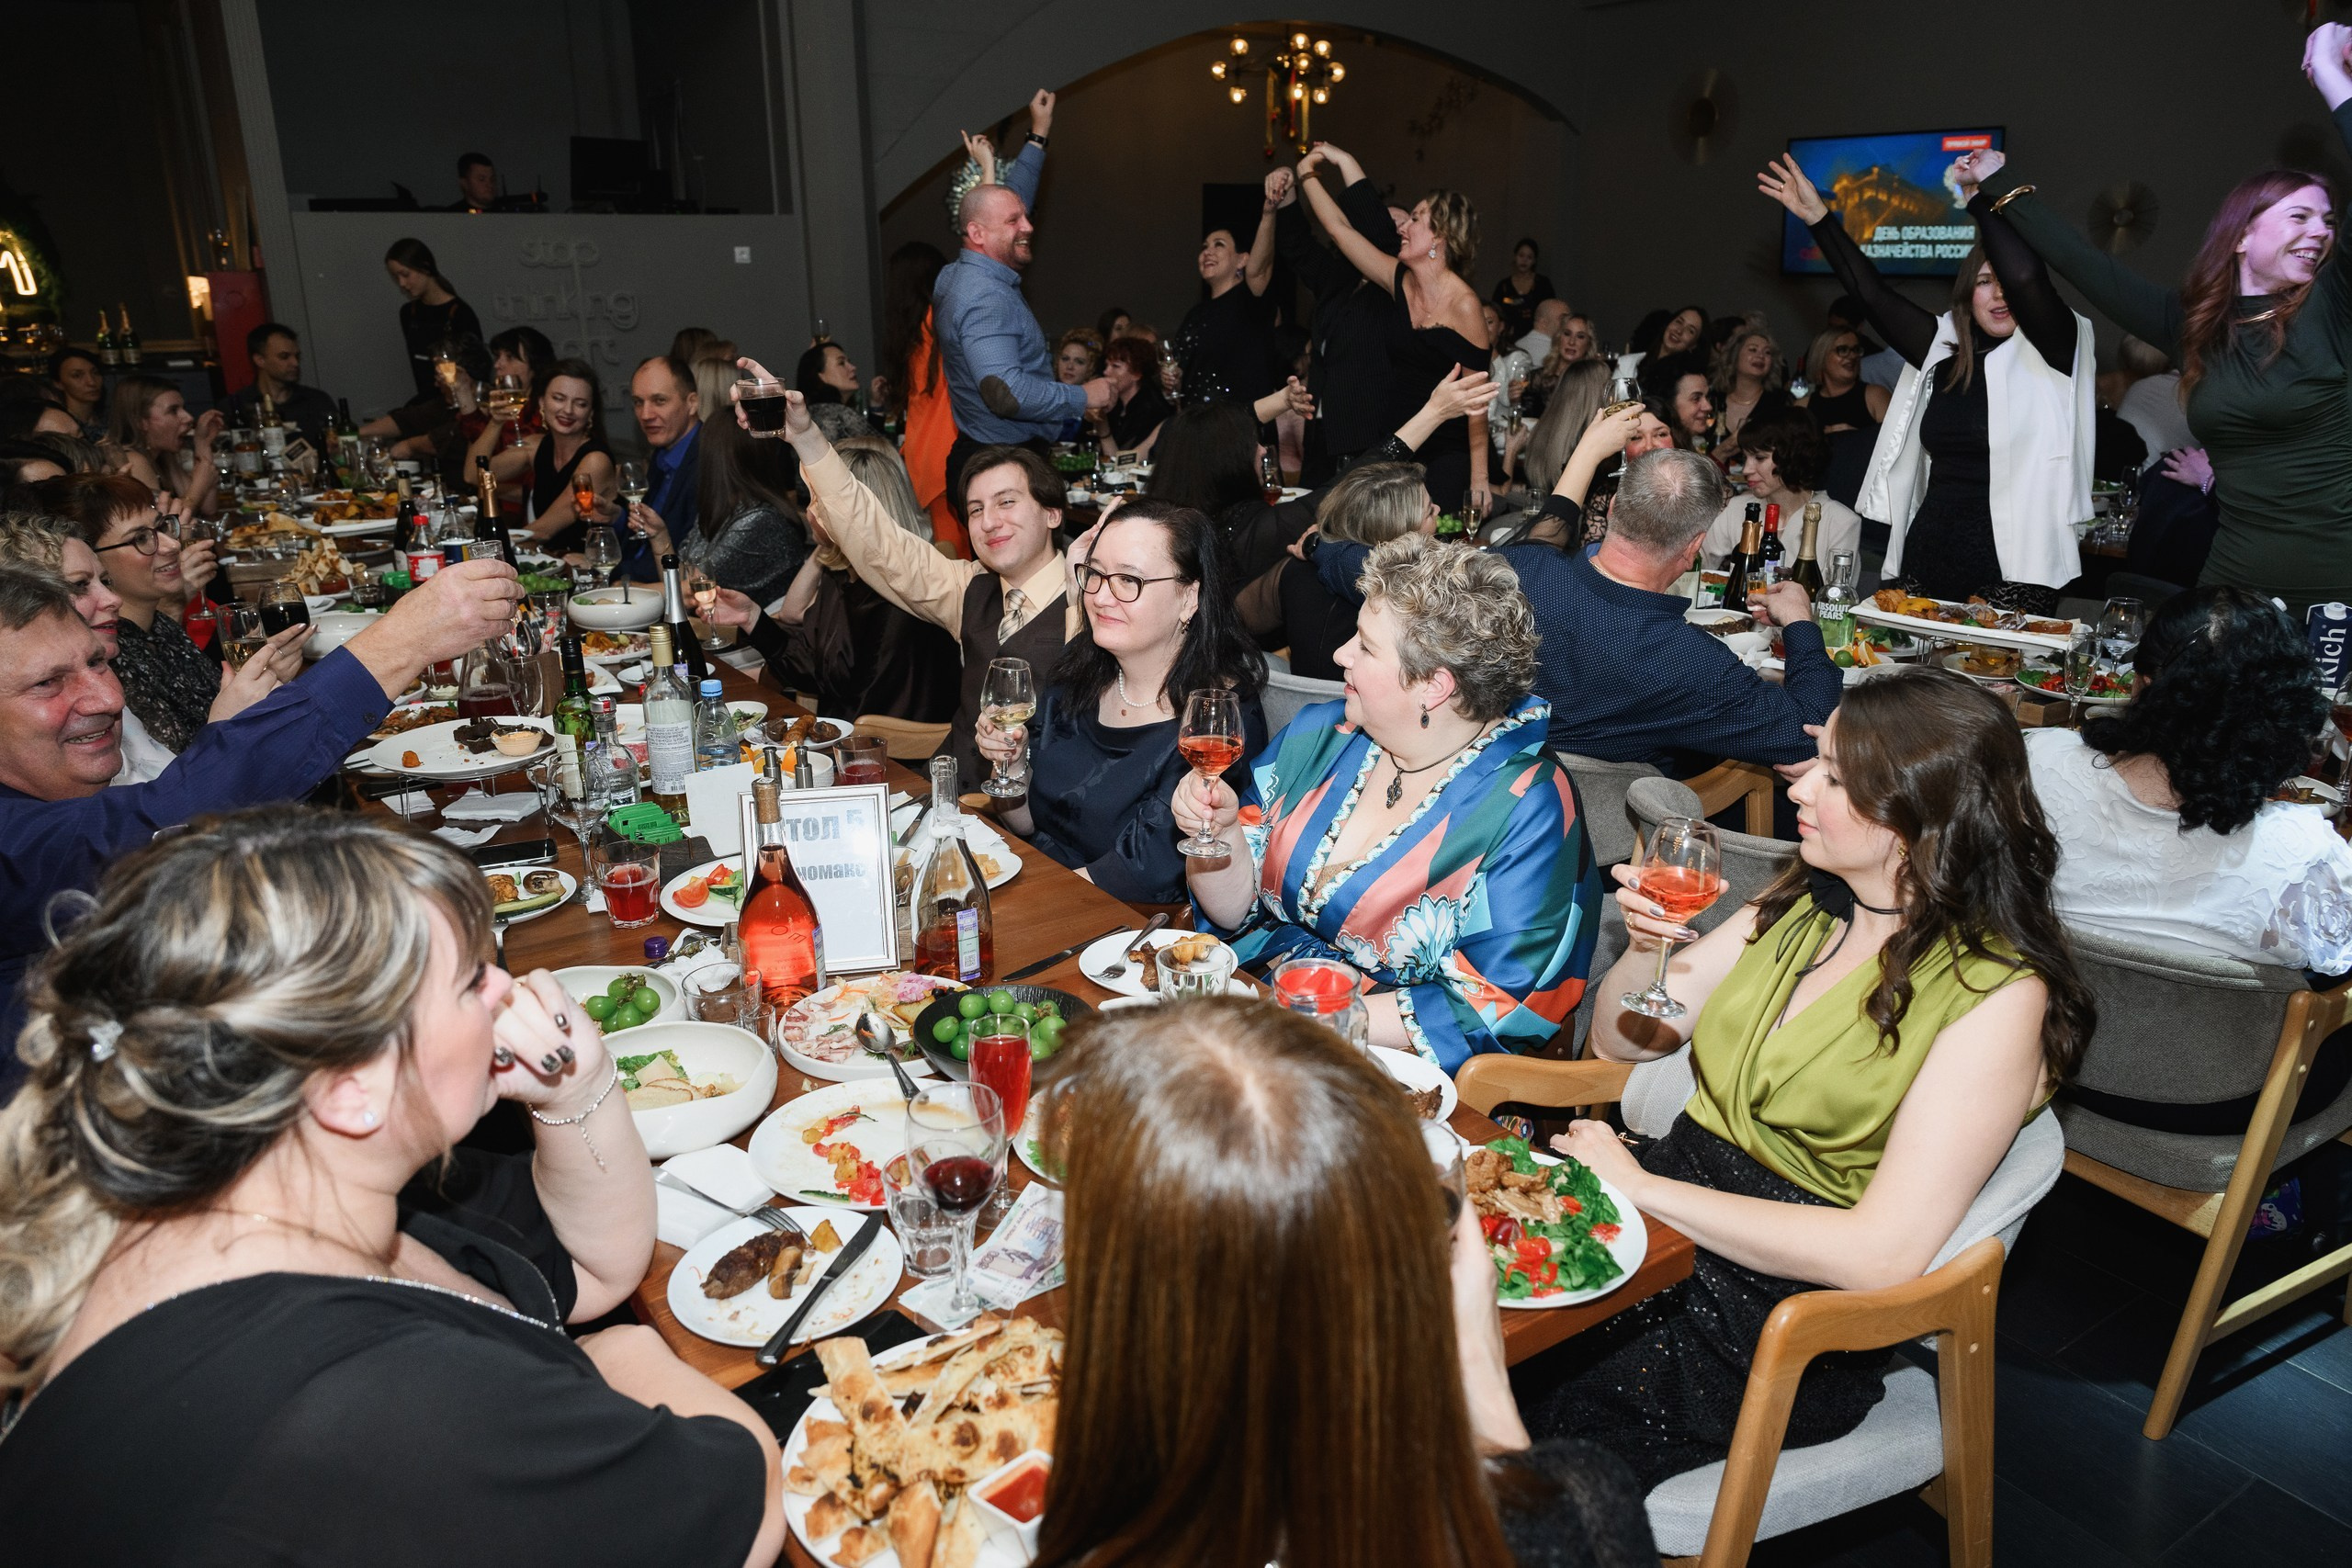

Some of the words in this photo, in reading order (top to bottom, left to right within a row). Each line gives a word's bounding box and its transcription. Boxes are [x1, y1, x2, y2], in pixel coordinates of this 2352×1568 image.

[1872, 226, 1900, 242] ДЕНЬ
[1901, 225, 1975, 241] ОБРАЗОВАНИЯ
[1817, 602, 1849, 613] ABSOLUT
[1819, 610, 1844, 620] PEARS
